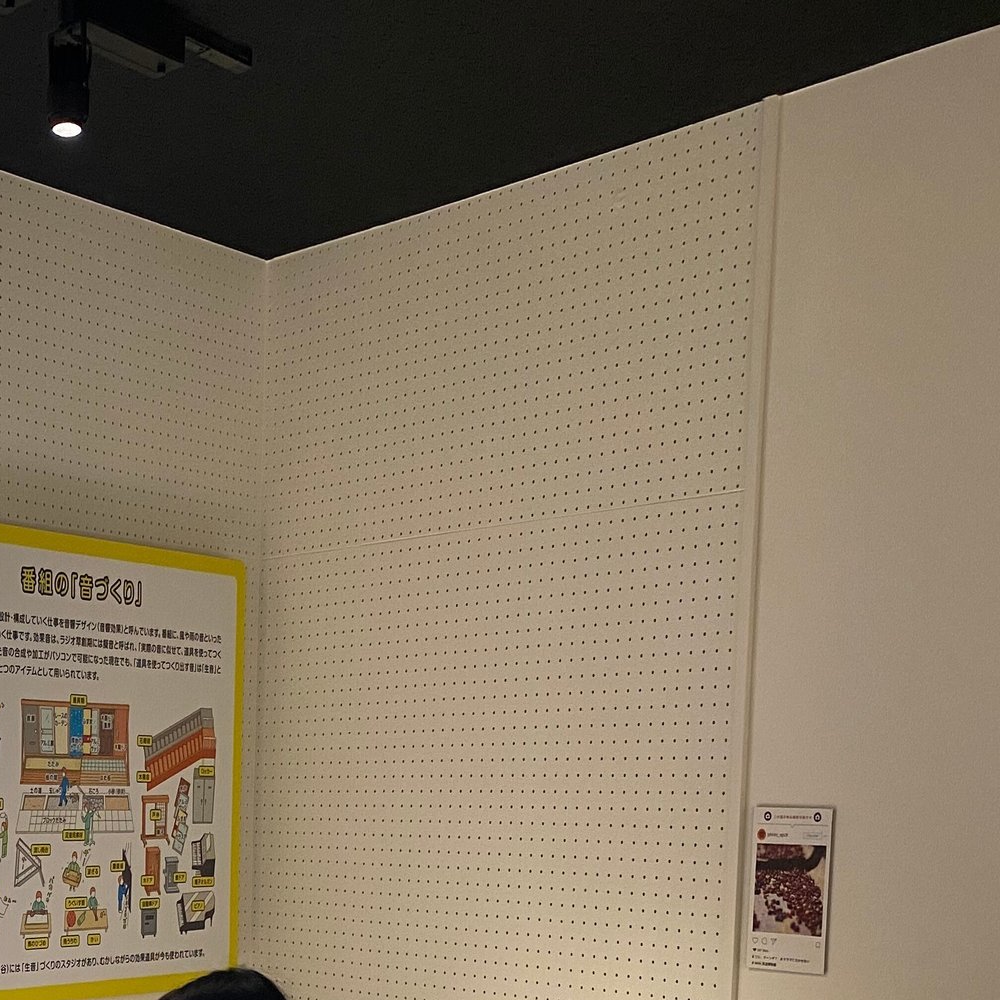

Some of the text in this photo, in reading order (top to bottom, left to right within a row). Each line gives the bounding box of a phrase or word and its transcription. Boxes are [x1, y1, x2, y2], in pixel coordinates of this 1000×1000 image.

[21, 566, 143, 607] 番組の「音づくり」
